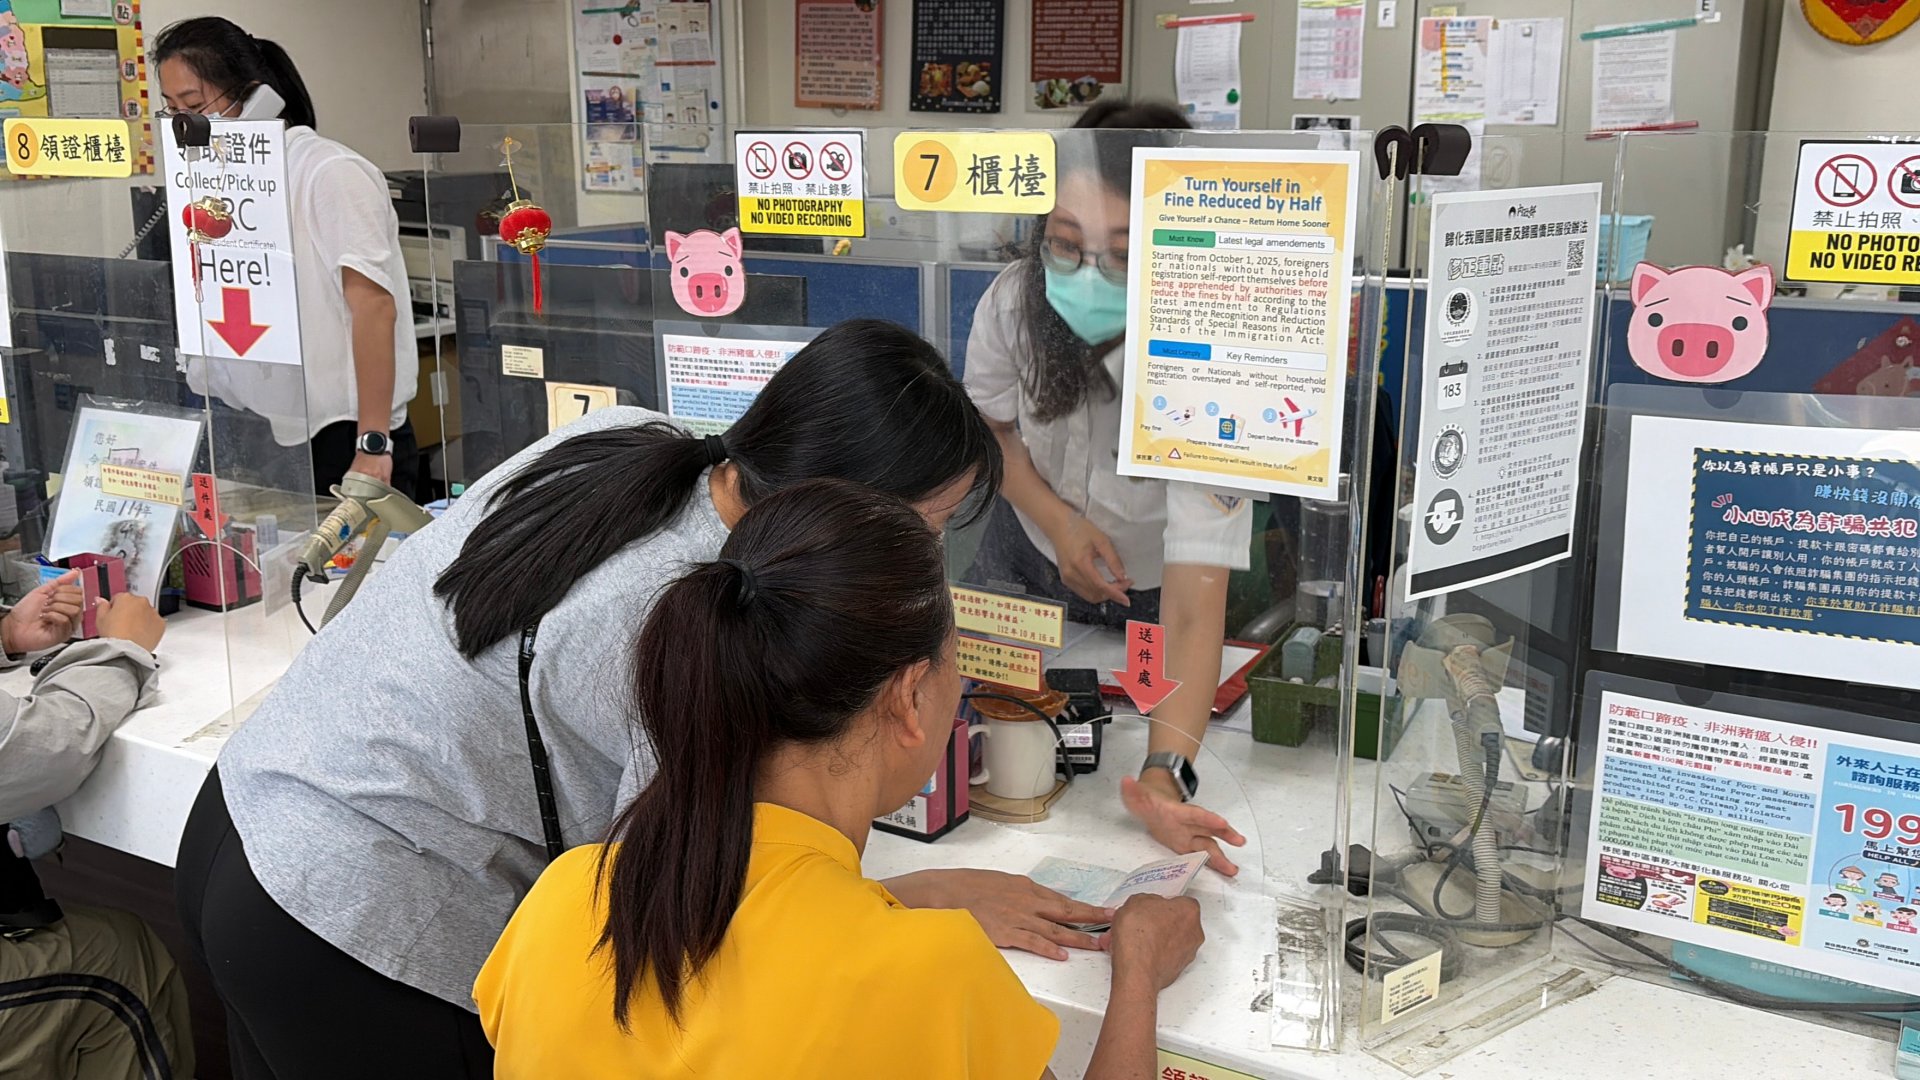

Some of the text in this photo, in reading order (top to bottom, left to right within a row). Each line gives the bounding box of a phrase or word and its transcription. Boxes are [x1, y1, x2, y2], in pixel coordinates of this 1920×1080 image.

[17, 132, 125, 163] 8 領證櫃檯
[175, 172, 277, 197] Collect/Pick up
[919, 153, 1048, 198] 7 櫃檯
[1184, 177, 1299, 193] Turn Yourself in
[747, 181, 852, 197] 禁止拍照、禁止錄影
[757, 198, 843, 213] NO PHOTOGRAPHY
[1165, 192, 1321, 213] Fine Reduced by Half
[751, 211, 852, 227] NO VIDEO RECORDING
[1214, 216, 1240, 224] Chance
[1249, 217, 1275, 225] Return
[1302, 219, 1329, 227] Sooner
[1168, 234, 1204, 243] Must Know
[1218, 236, 1325, 248] Latest legal amendements
[1826, 233, 1852, 250] NO
[200, 248, 271, 287] Here!
[1152, 251, 1329, 269] Starting from October 1, 2025, foreigners
[1169, 261, 1216, 271] nationals
[1224, 264, 1263, 273] without
[1271, 267, 1328, 277] household
[1447, 254, 1505, 280] 修正重點
[1810, 251, 1835, 269] NO
[1842, 253, 1896, 271] VIDEO
[1151, 270, 1327, 287] registration self-report themselves before
[1150, 279, 1327, 298] being apprehended by authorities may
[1150, 288, 1179, 296] reduce
[1198, 291, 1218, 299] fines
[1221, 292, 1232, 302] by
[1234, 293, 1251, 301] half
[1252, 294, 1295, 306] according
[1298, 297, 1309, 305] to
[1311, 298, 1326, 306] the
[1149, 306, 1192, 317] Governing
[1194, 309, 1208, 317] the
[1210, 310, 1259, 322] Recognition
[1280, 315, 1325, 325] Reduction
[1150, 297, 1326, 317] latest amendment to Regulations
[1149, 315, 1324, 335] Standards of Special Reasons in Article
[1149, 324, 1324, 344] 74-1 of the Immigration Act.
[1226, 352, 1288, 364] Key Reminders
[1147, 362, 1184, 373] Foreigners
[1208, 367, 1241, 376] Nationals
[1249, 371, 1278, 380] without
[1286, 374, 1325, 384] household
[1147, 370, 1187, 381] registration
[1192, 374, 1231, 385] overstayed
[1254, 380, 1306, 392] self-reported,
[1311, 386, 1326, 394] you
[1443, 383, 1461, 398] 183
[573, 394, 590, 415] 7
[1723, 505, 1918, 539] 小心成為詐騙共犯
[1137, 627, 1154, 688] 送件處
[1619, 758, 1652, 771] prevent
[1677, 769, 1716, 782] invasion
[1736, 781, 1756, 790] Foot
[1761, 785, 1777, 794] and
[1783, 790, 1809, 800] Mouth
[1868, 852, 1909, 865] HELP ALL
